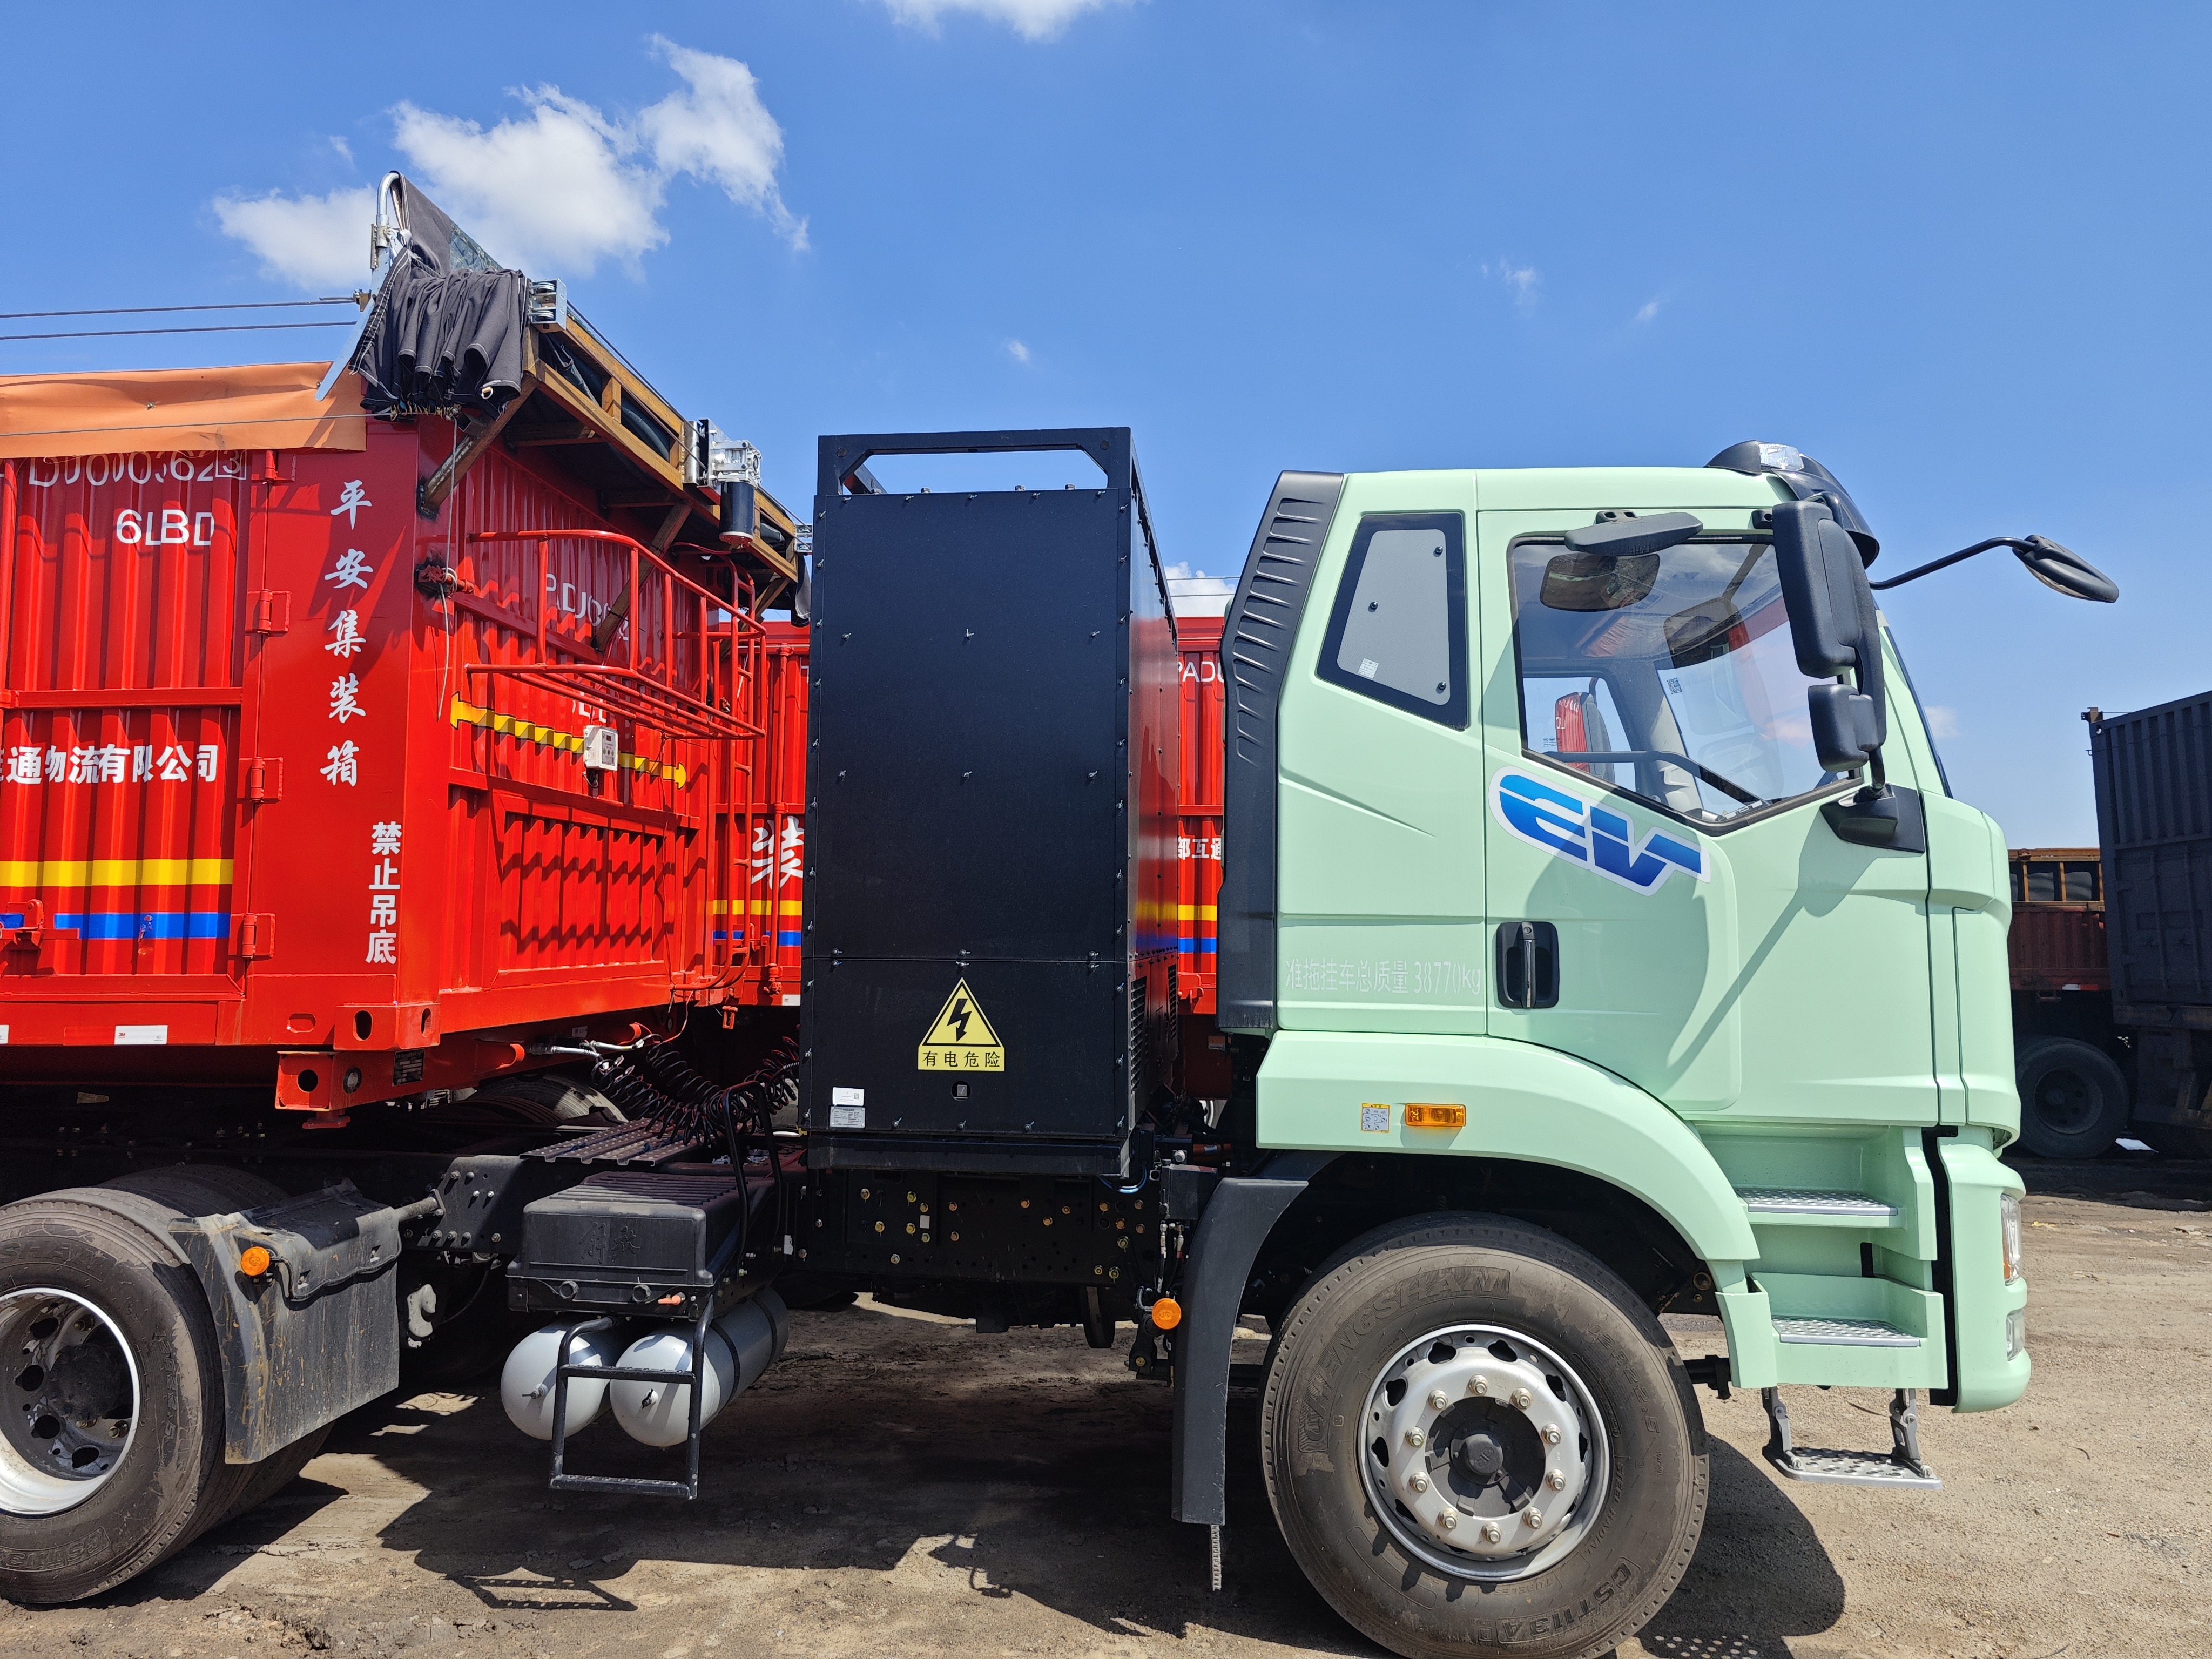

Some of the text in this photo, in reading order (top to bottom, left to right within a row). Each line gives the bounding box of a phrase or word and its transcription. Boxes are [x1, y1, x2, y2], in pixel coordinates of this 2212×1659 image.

[320, 480, 373, 786] 平安集装箱
[0, 744, 218, 784] 通物流有限公司
[366, 821, 403, 965] 禁止吊底
[1286, 958, 1481, 995] 准拖挂车总质量 38770kg
[922, 1050, 1000, 1068] 有电危险
[1305, 1270, 1501, 1441] CHENGSHAN
